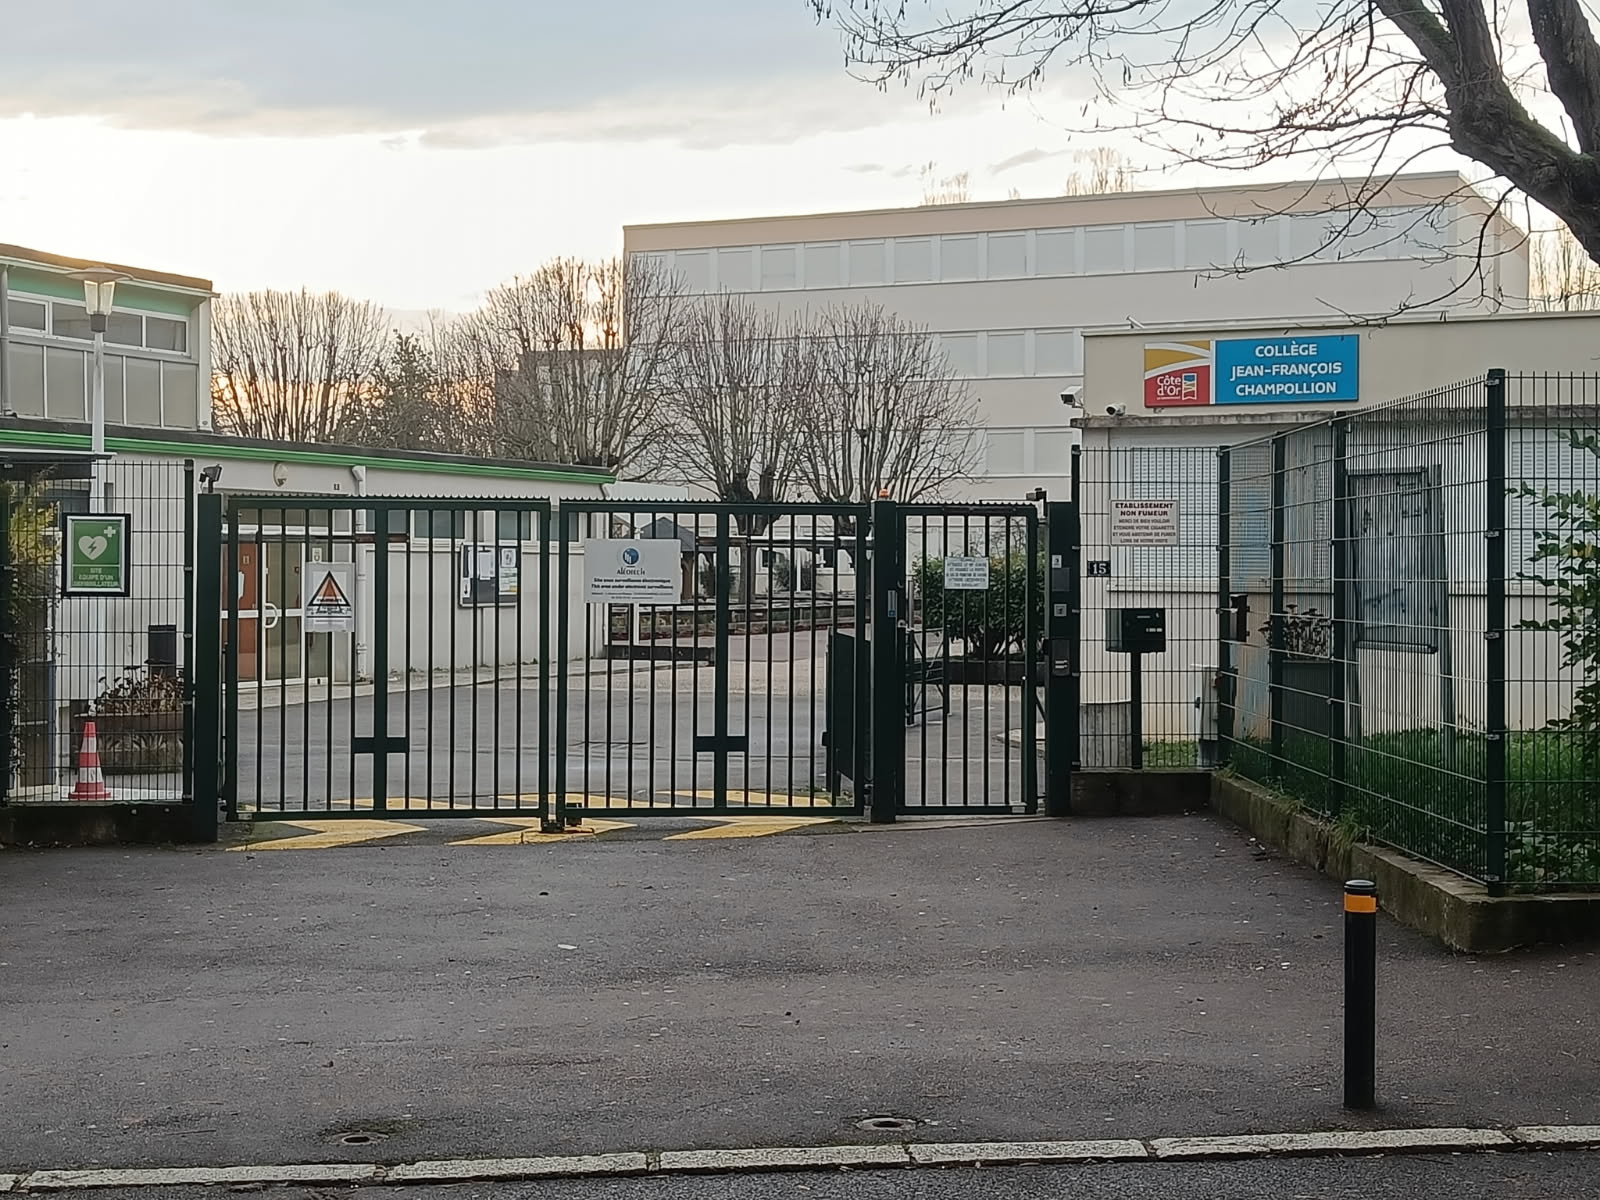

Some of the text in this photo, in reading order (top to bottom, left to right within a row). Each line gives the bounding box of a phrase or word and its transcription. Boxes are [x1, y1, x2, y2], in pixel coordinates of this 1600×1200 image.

[1255, 340, 1318, 357] COLLÈGE
[1230, 362, 1342, 381] JEAN-FRANÇOIS
[1156, 374, 1182, 385] Côte
[1156, 384, 1182, 396] d'Or
[1236, 382, 1336, 396] CHAMPOLLION
[1093, 563, 1107, 574] 15
